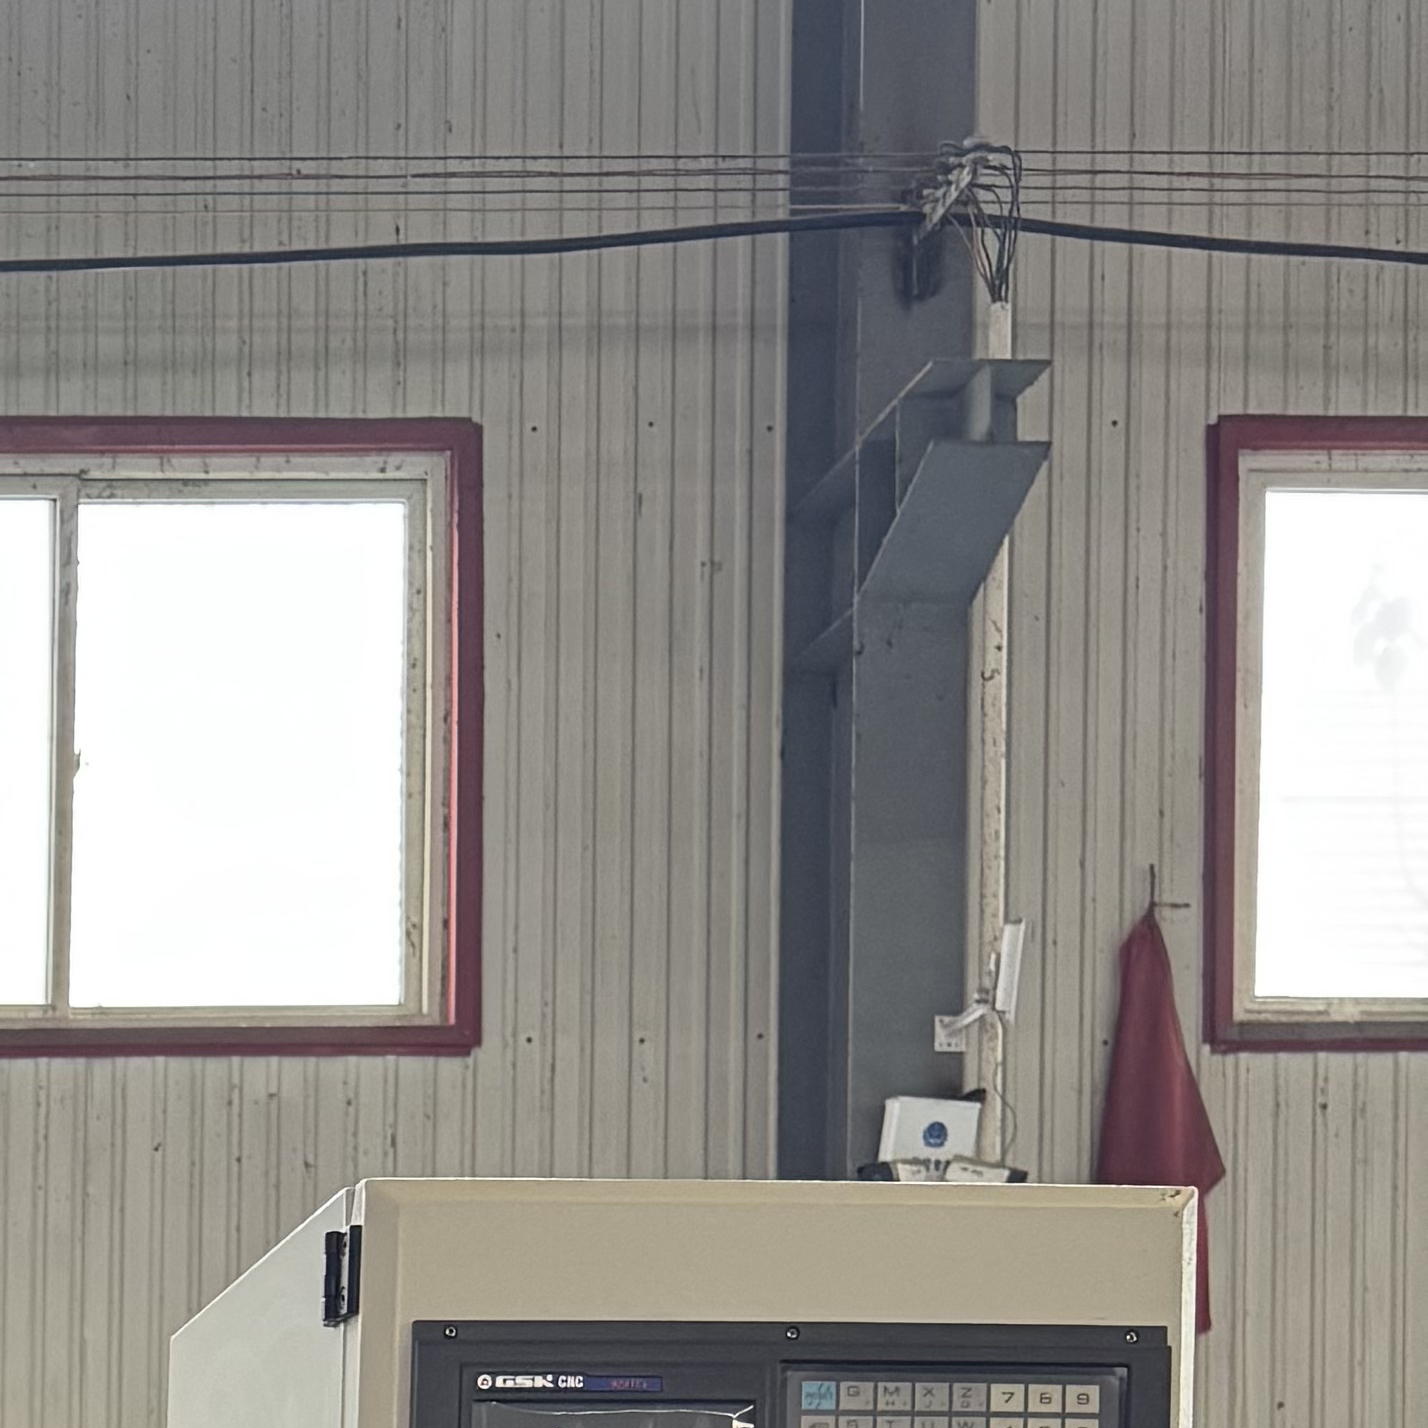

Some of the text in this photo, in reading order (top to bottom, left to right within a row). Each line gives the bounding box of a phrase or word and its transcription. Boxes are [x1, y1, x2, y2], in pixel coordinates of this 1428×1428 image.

[495, 1375, 583, 1388] GSK CNC
[1000, 1391, 1016, 1405] 7
[1076, 1392, 1091, 1406] 9
